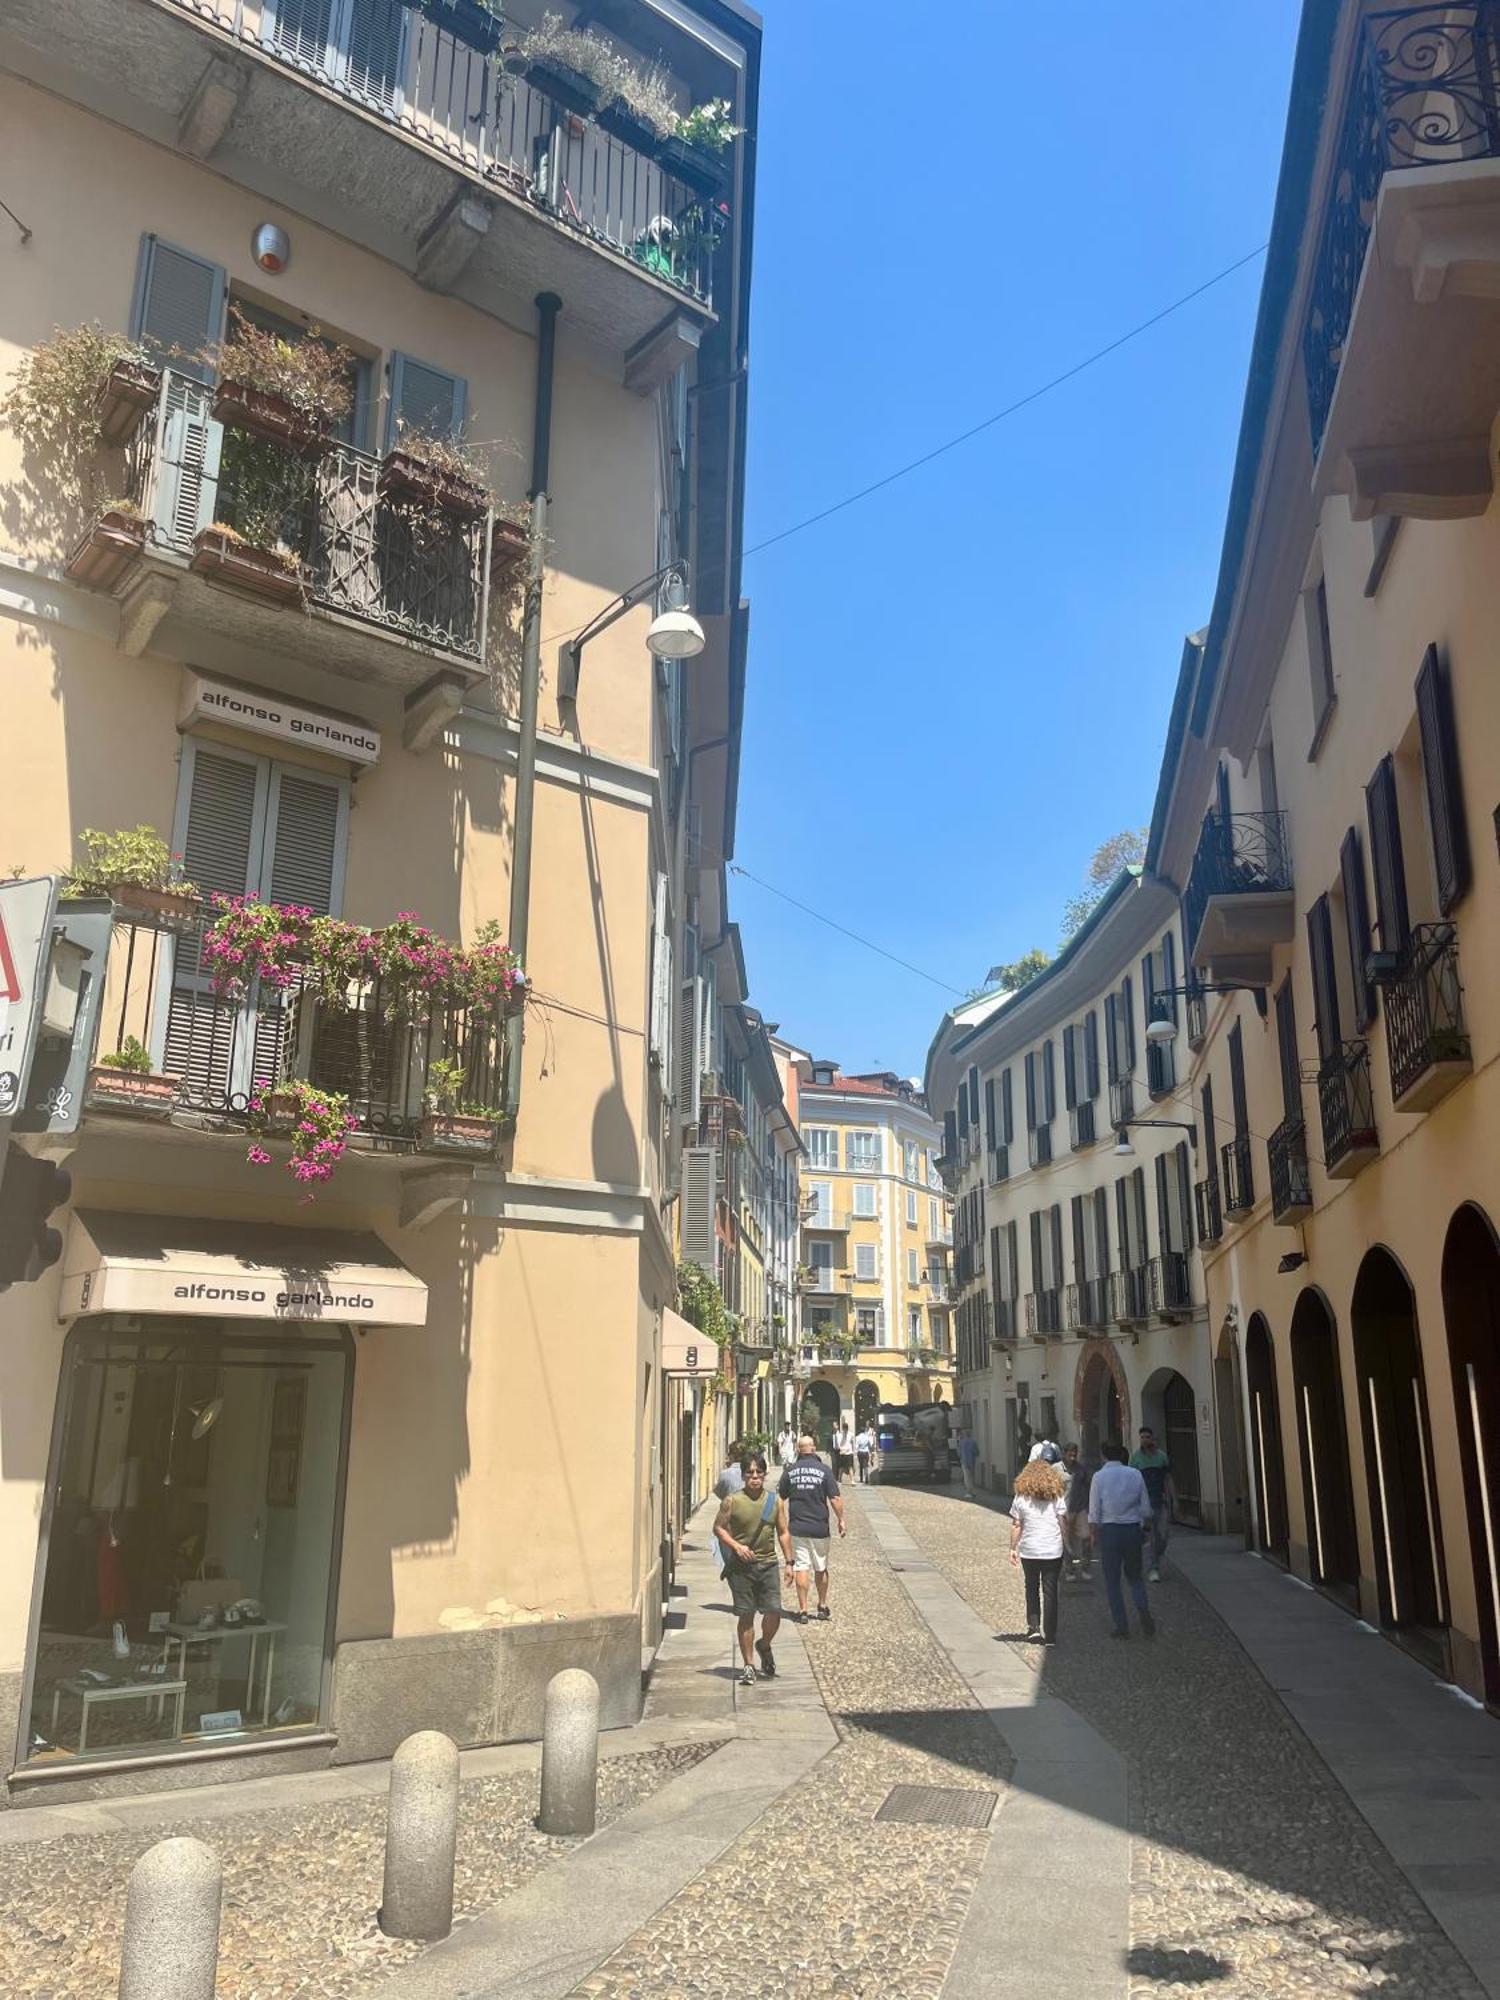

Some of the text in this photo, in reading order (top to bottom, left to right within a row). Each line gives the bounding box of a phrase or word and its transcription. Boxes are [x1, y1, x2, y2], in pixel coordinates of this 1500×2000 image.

[202, 691, 376, 751] alfonso garlando
[174, 1283, 374, 1309] alfonso garlando
